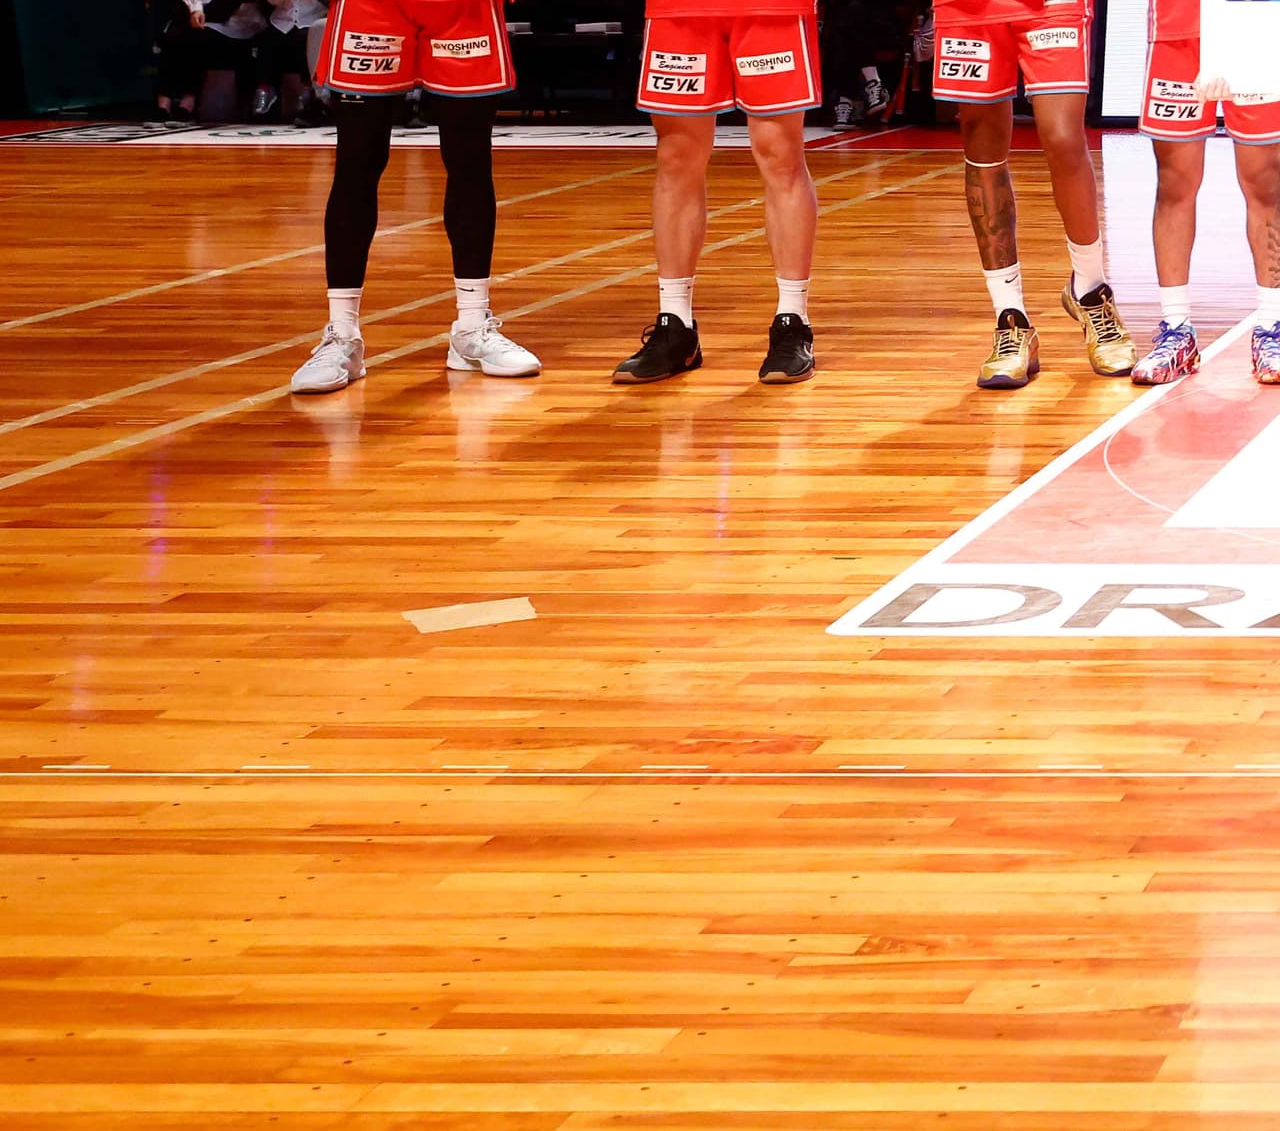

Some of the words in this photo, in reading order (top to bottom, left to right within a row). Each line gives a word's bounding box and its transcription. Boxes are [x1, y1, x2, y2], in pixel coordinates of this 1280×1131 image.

[1034, 31, 1076, 41] YOSHINO
[441, 40, 488, 51] YOSHINO
[747, 55, 791, 68] YOSHINO
